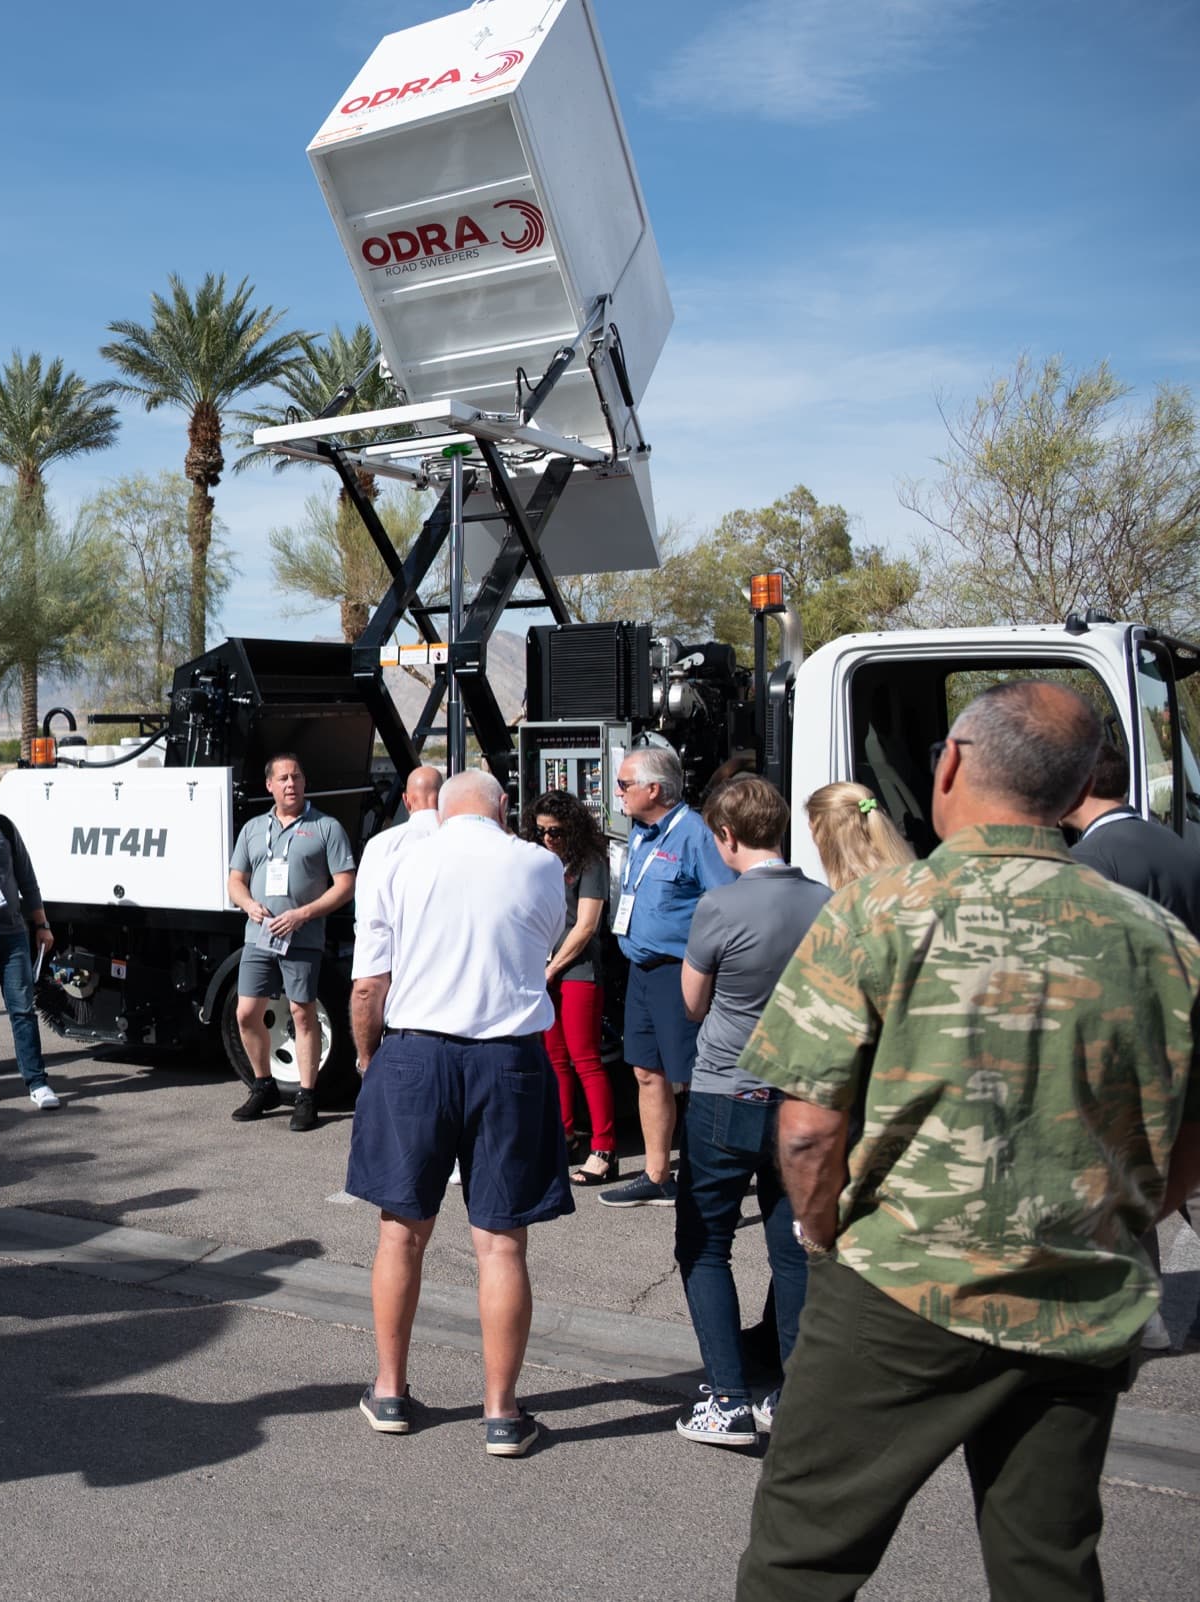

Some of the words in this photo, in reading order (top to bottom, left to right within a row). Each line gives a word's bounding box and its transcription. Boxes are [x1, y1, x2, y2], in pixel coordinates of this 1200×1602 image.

[341, 68, 461, 114] ODRA
[361, 215, 490, 266] ODRA
[385, 260, 417, 278] ROAD
[420, 248, 480, 269] SWEEPERS
[71, 827, 168, 857] MT4H
